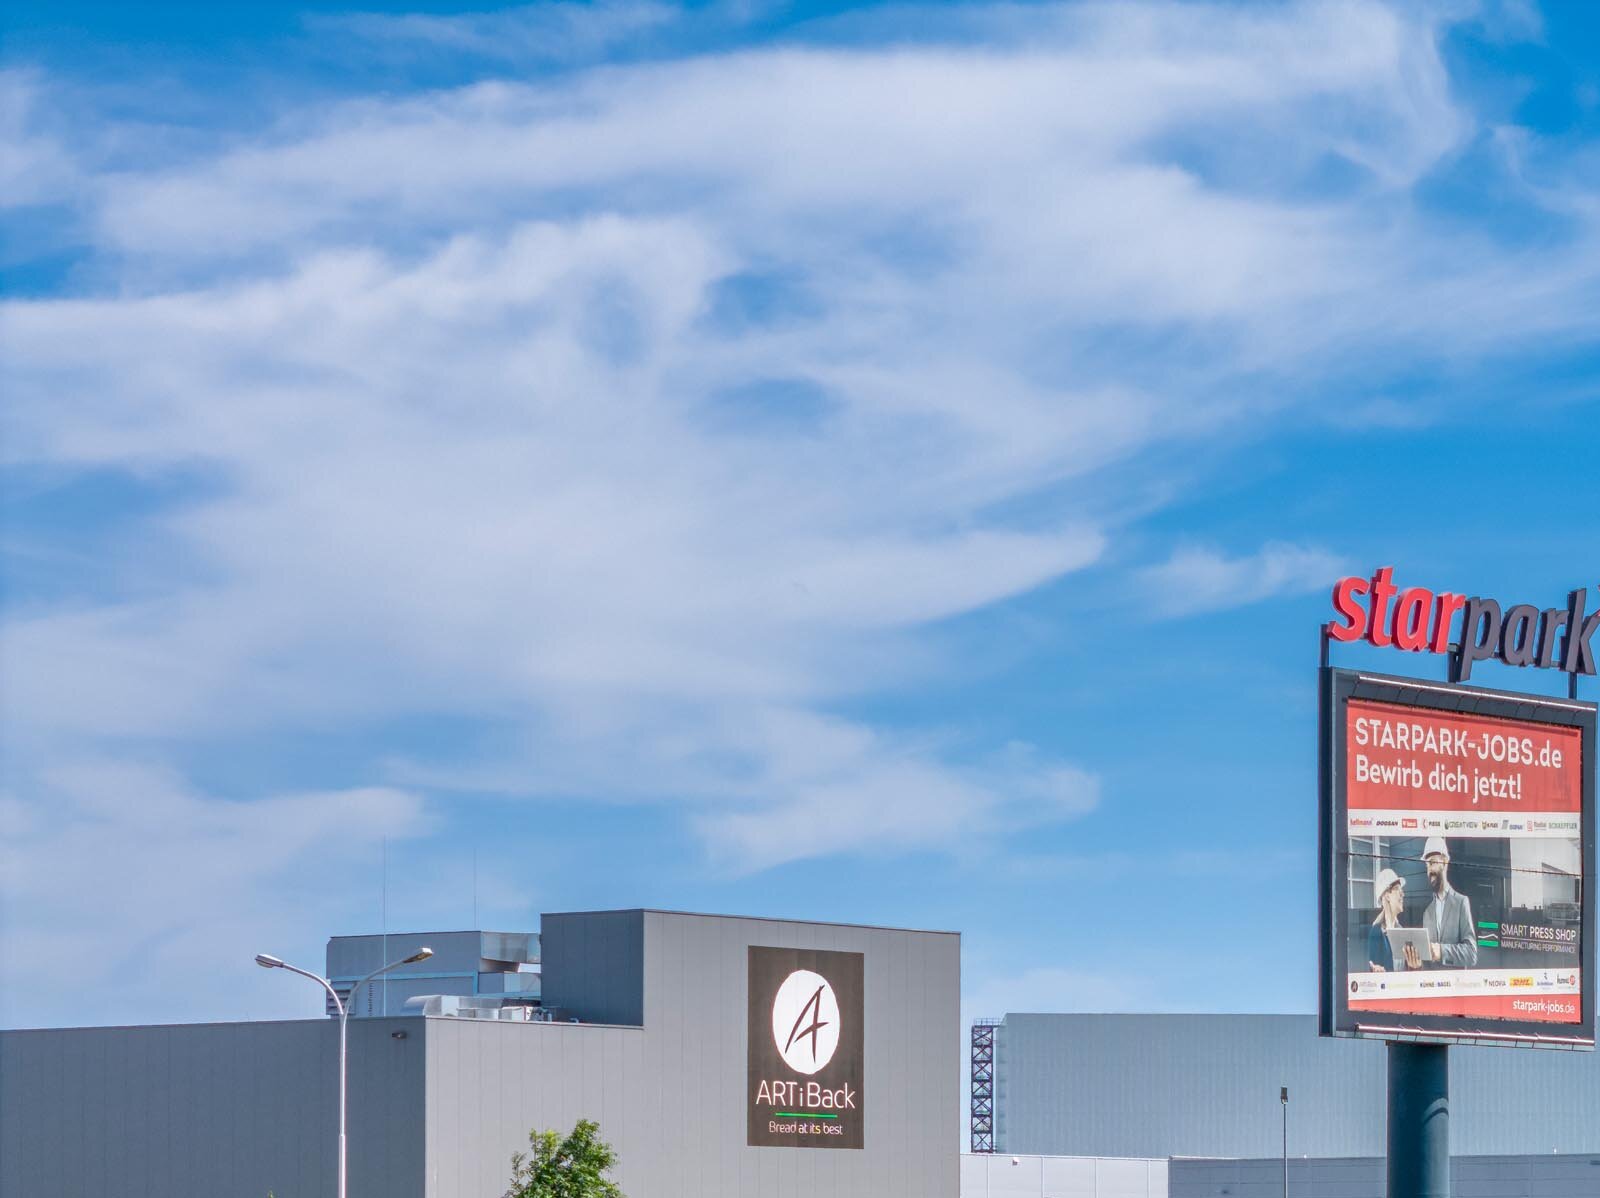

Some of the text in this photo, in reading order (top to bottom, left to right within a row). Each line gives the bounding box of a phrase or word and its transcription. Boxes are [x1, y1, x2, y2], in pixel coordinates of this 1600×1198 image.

[1355, 717, 1562, 769] STARPARK-JOBS.de
[1356, 754, 1522, 804] Bewirb dich jetzt!
[1501, 923, 1577, 942] SMART PRESS SHOP
[1501, 941, 1576, 954] MANUFACTURING PERFORMANCE
[1512, 998, 1575, 1015] starpark-jobs.de
[769, 1121, 843, 1135] Bread at its best
